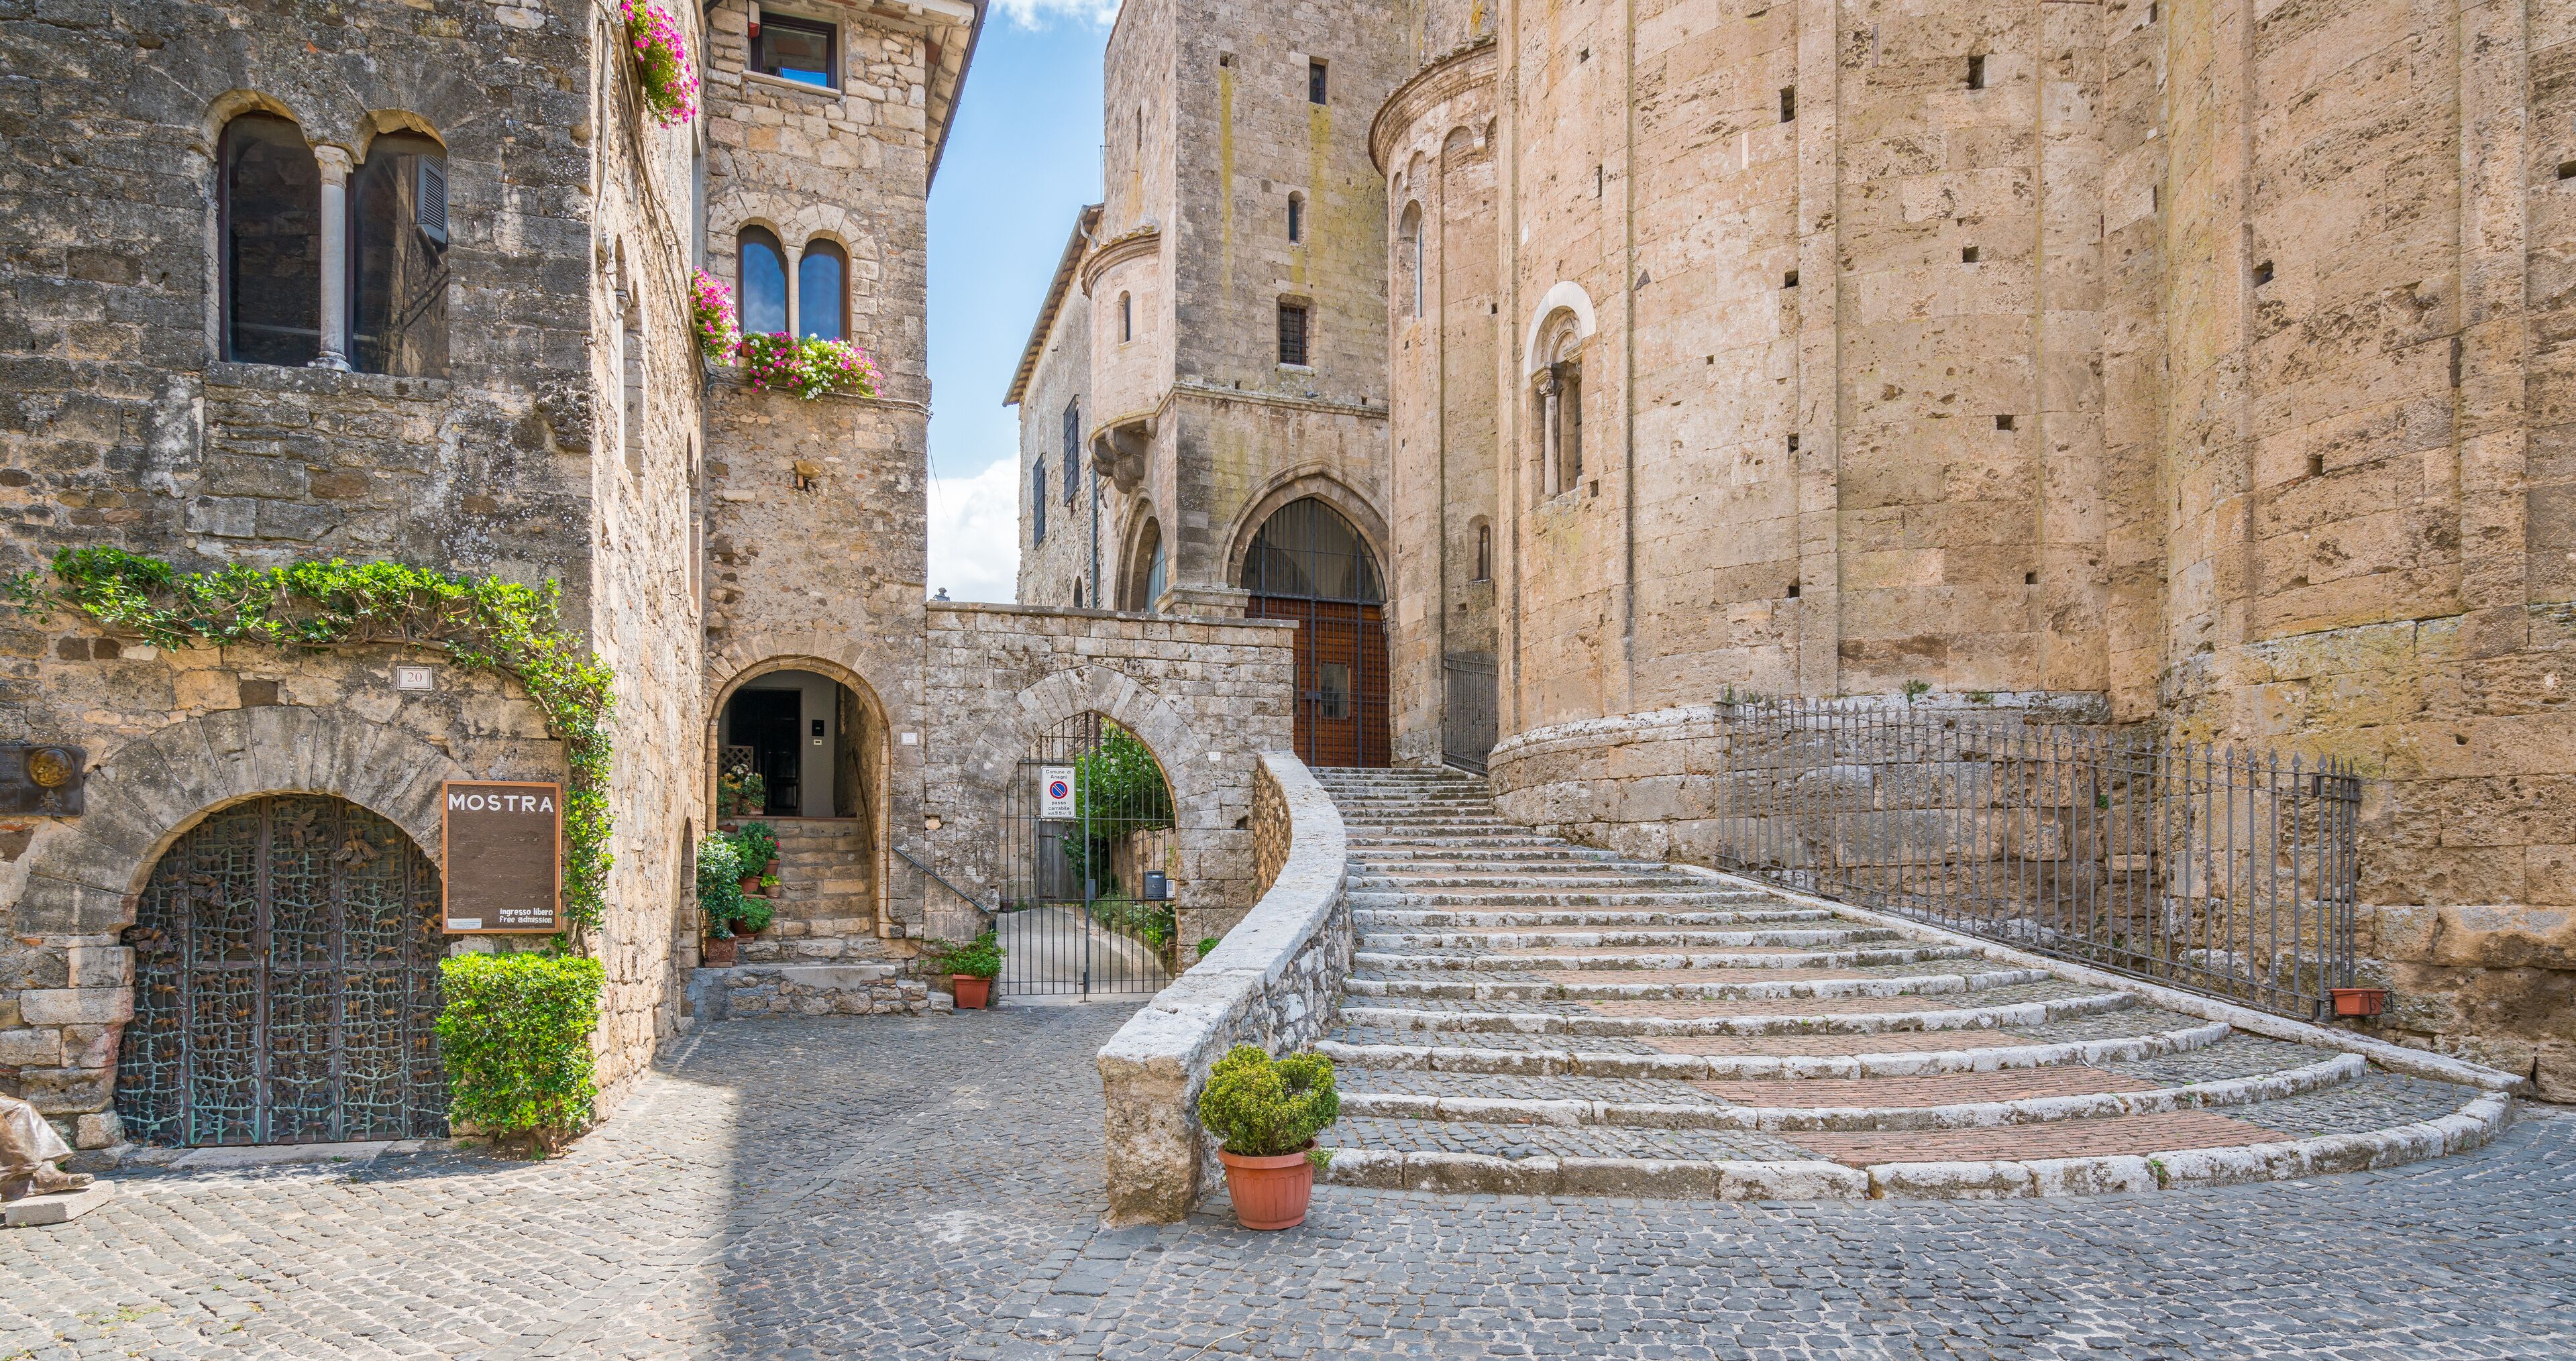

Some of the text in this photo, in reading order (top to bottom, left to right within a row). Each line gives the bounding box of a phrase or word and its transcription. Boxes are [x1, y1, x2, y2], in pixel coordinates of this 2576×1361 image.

[407, 671, 423, 683] 20
[448, 794, 554, 812] MOSTRA
[499, 907, 553, 917] ingresso libero
[499, 915, 552, 924] free admission
